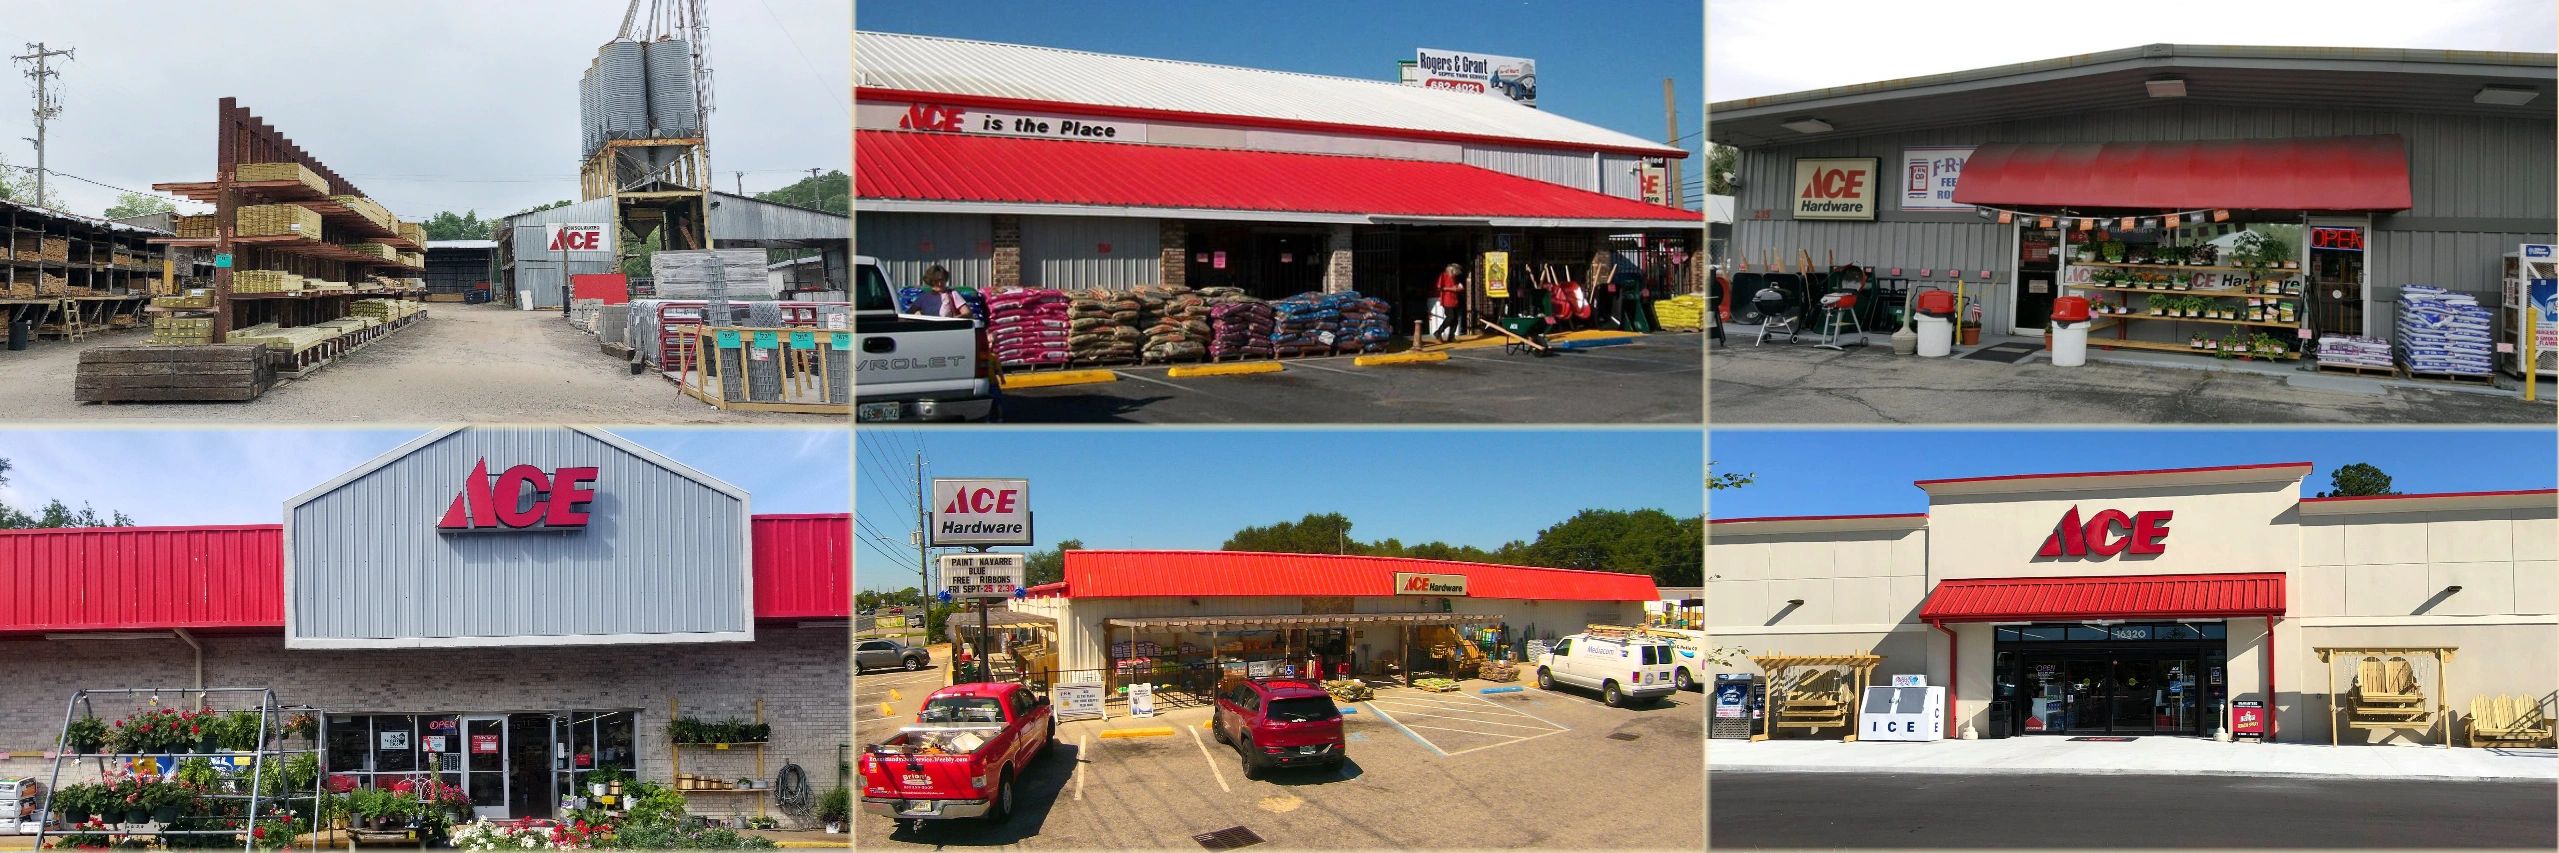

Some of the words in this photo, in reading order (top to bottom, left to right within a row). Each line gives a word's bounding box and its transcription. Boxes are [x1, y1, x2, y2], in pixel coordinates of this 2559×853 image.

[1420, 52, 1452, 74] Rogers
[1454, 55, 1460, 72] &
[1462, 56, 1488, 75] Grant
[899, 102, 966, 132] ACE
[982, 114, 1003, 131] is
[1014, 118, 1050, 133] the
[1060, 120, 1117, 138] Place
[1801, 165, 1867, 199] ACE
[1941, 177, 1957, 187] FEE
[1937, 190, 1954, 200] RO
[1800, 201, 1864, 213] Hardware
[549, 228, 600, 250] ACE
[2311, 227, 2364, 249] OPEN
[2192, 272, 2217, 288] CE
[2221, 273, 2300, 290] Harre
[437, 455, 599, 529] ACE
[944, 485, 1018, 514] ACE
[941, 520, 1023, 534] Hardware
[2038, 503, 2174, 557] ACE
[951, 558, 973, 566] PAINT
[980, 557, 1012, 566] NAVARRE
[968, 567, 986, 575] BLUE
[952, 576, 970, 584] FREE
[980, 575, 1011, 583] RIBBONS
[1403, 576, 1430, 591] ACE
[1429, 582, 1463, 592] Hardware
[948, 585, 960, 593] FRI
[2116, 629, 2146, 640] 16320
[1587, 645, 1614, 656] Mediacom
[1872, 721, 1915, 733] ICE
[902, 773, 931, 781] Brian's
